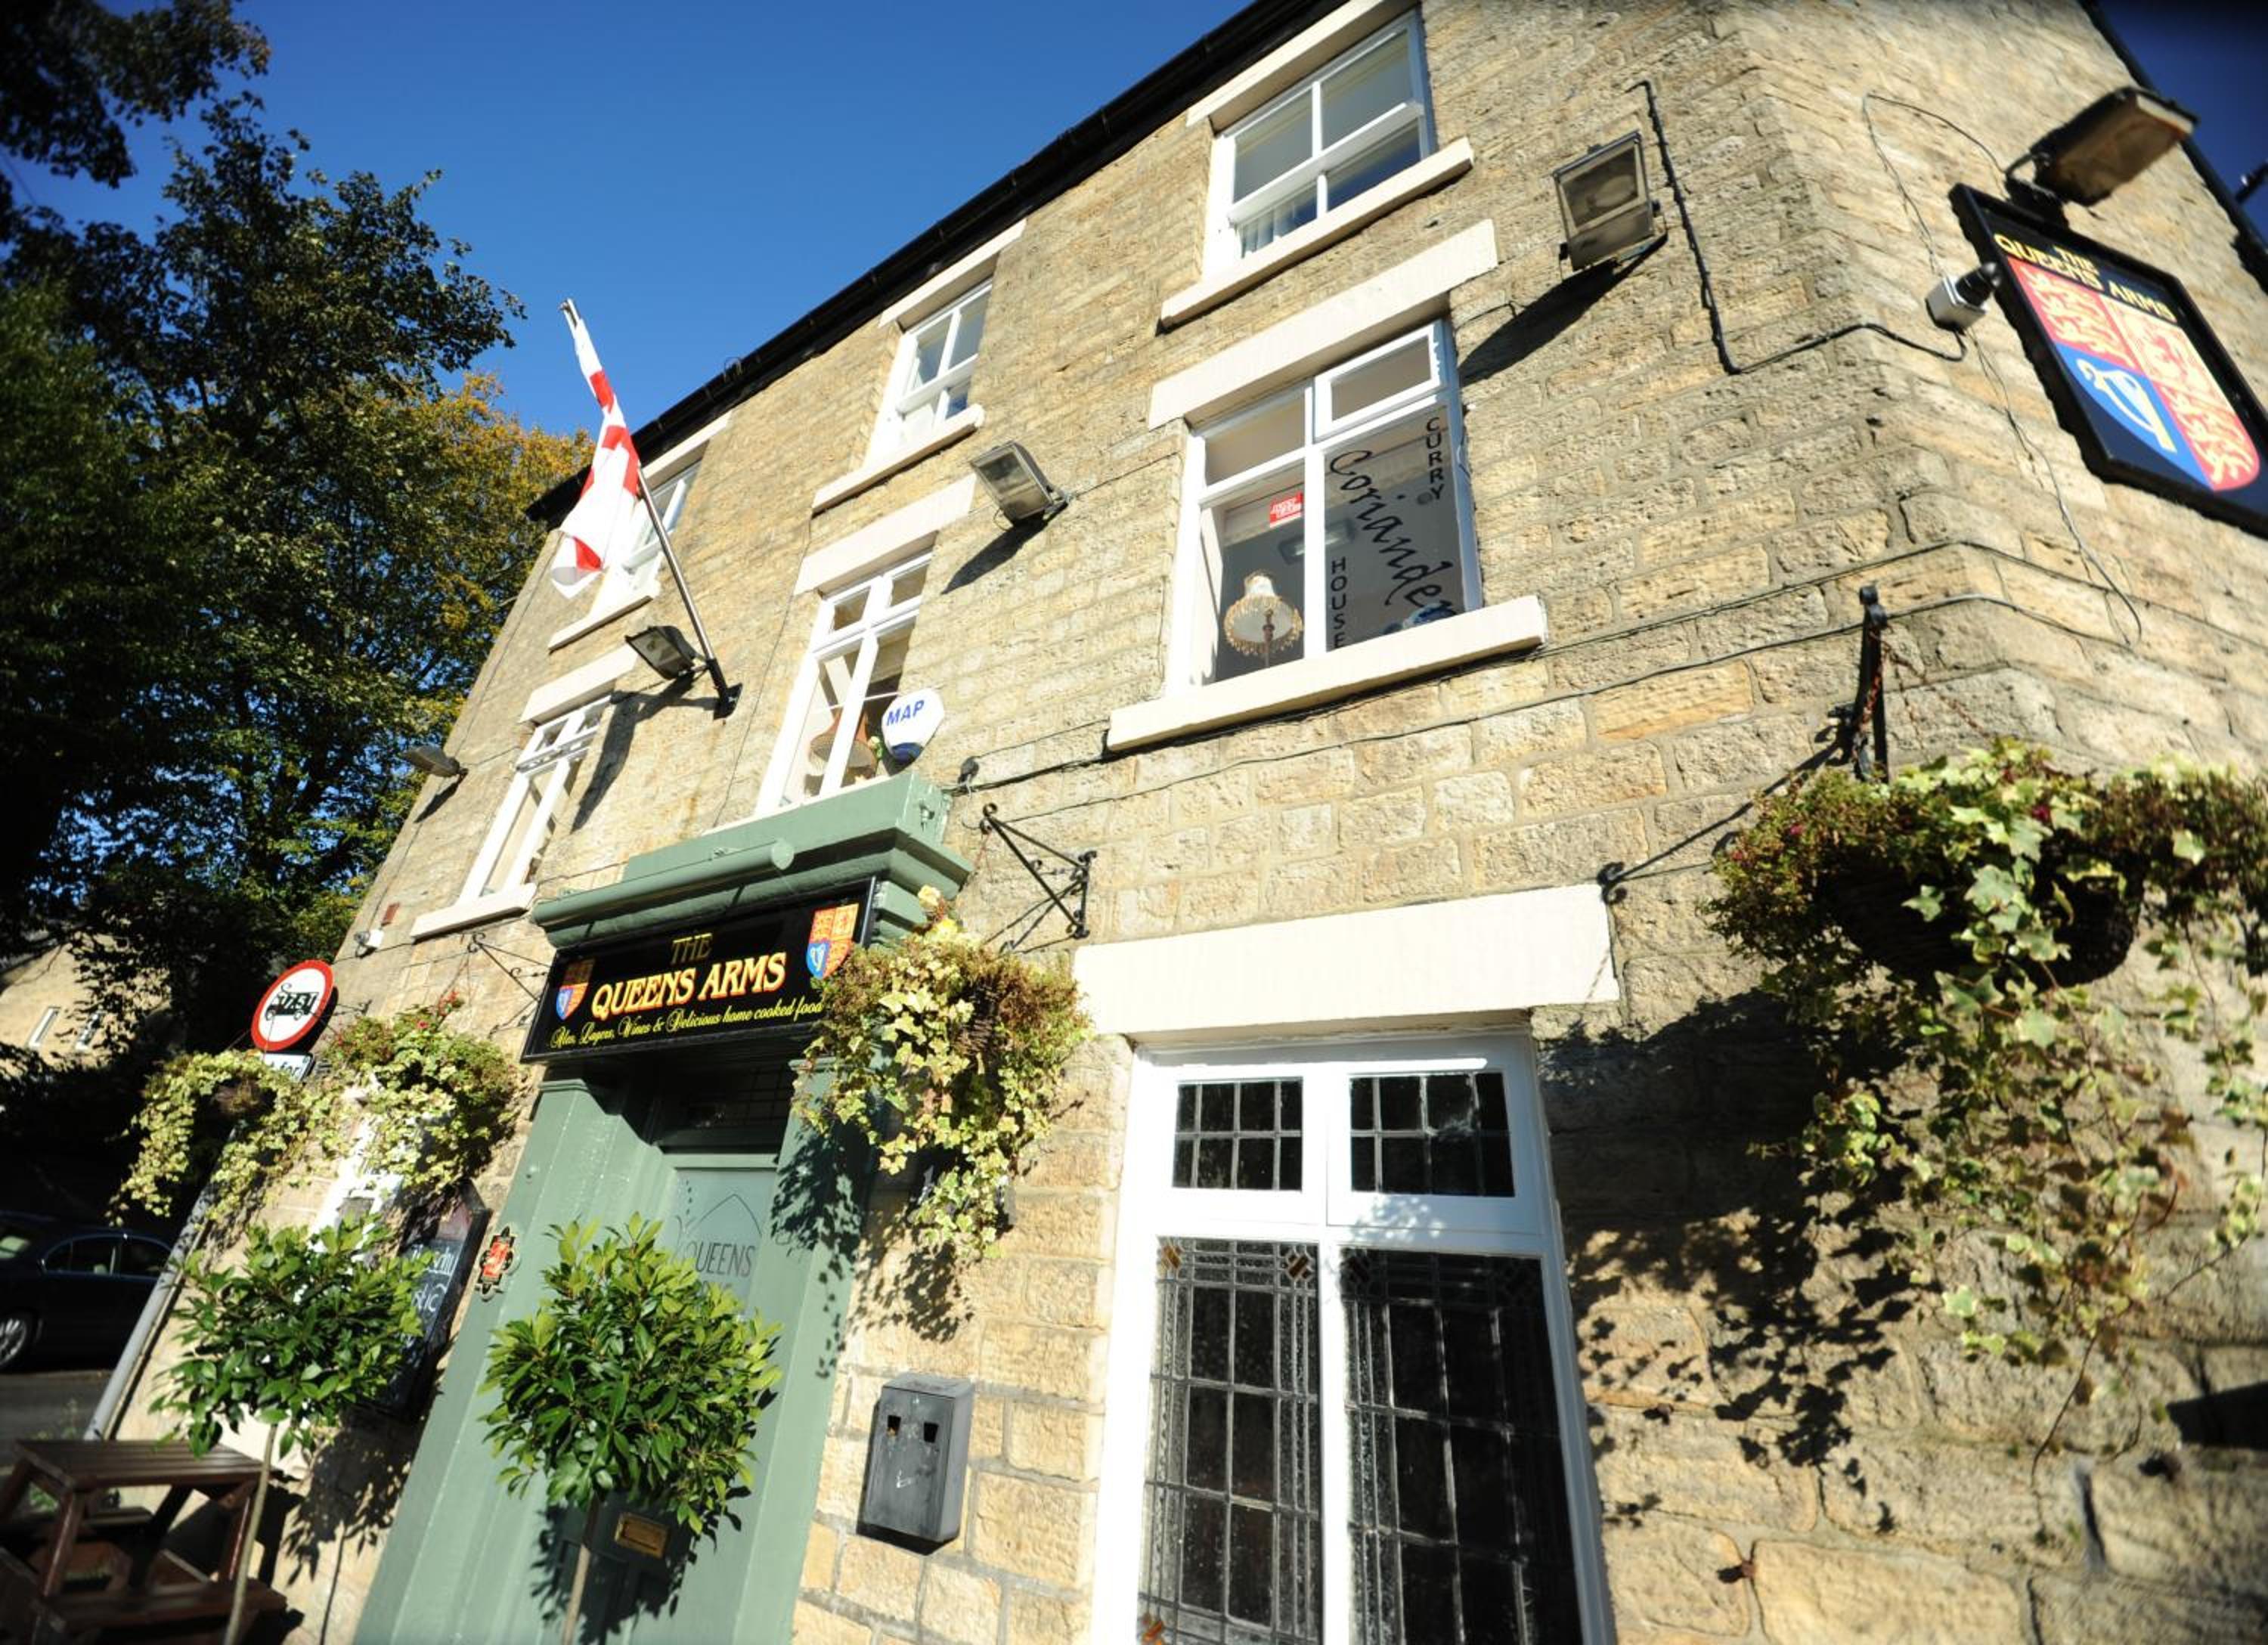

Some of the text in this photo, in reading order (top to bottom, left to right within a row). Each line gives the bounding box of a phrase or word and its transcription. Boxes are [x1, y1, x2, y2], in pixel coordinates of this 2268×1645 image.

[1993, 233, 2177, 324] QUEENS ARMS
[2053, 244, 2100, 277] THE
[1426, 417, 1444, 500] CURRY
[1329, 450, 1458, 616] Coriander
[1331, 557, 1346, 649] HOUSE
[887, 699, 925, 726] MAP
[671, 932, 713, 965] THE
[592, 951, 788, 1021] QUEENS ARMS
[617, 1015, 652, 1038] Wines
[652, 1016, 665, 1033] &
[666, 1008, 721, 1033] Delicious
[722, 1005, 753, 1024] home
[753, 998, 797, 1019] cooked
[792, 995, 825, 1023] food
